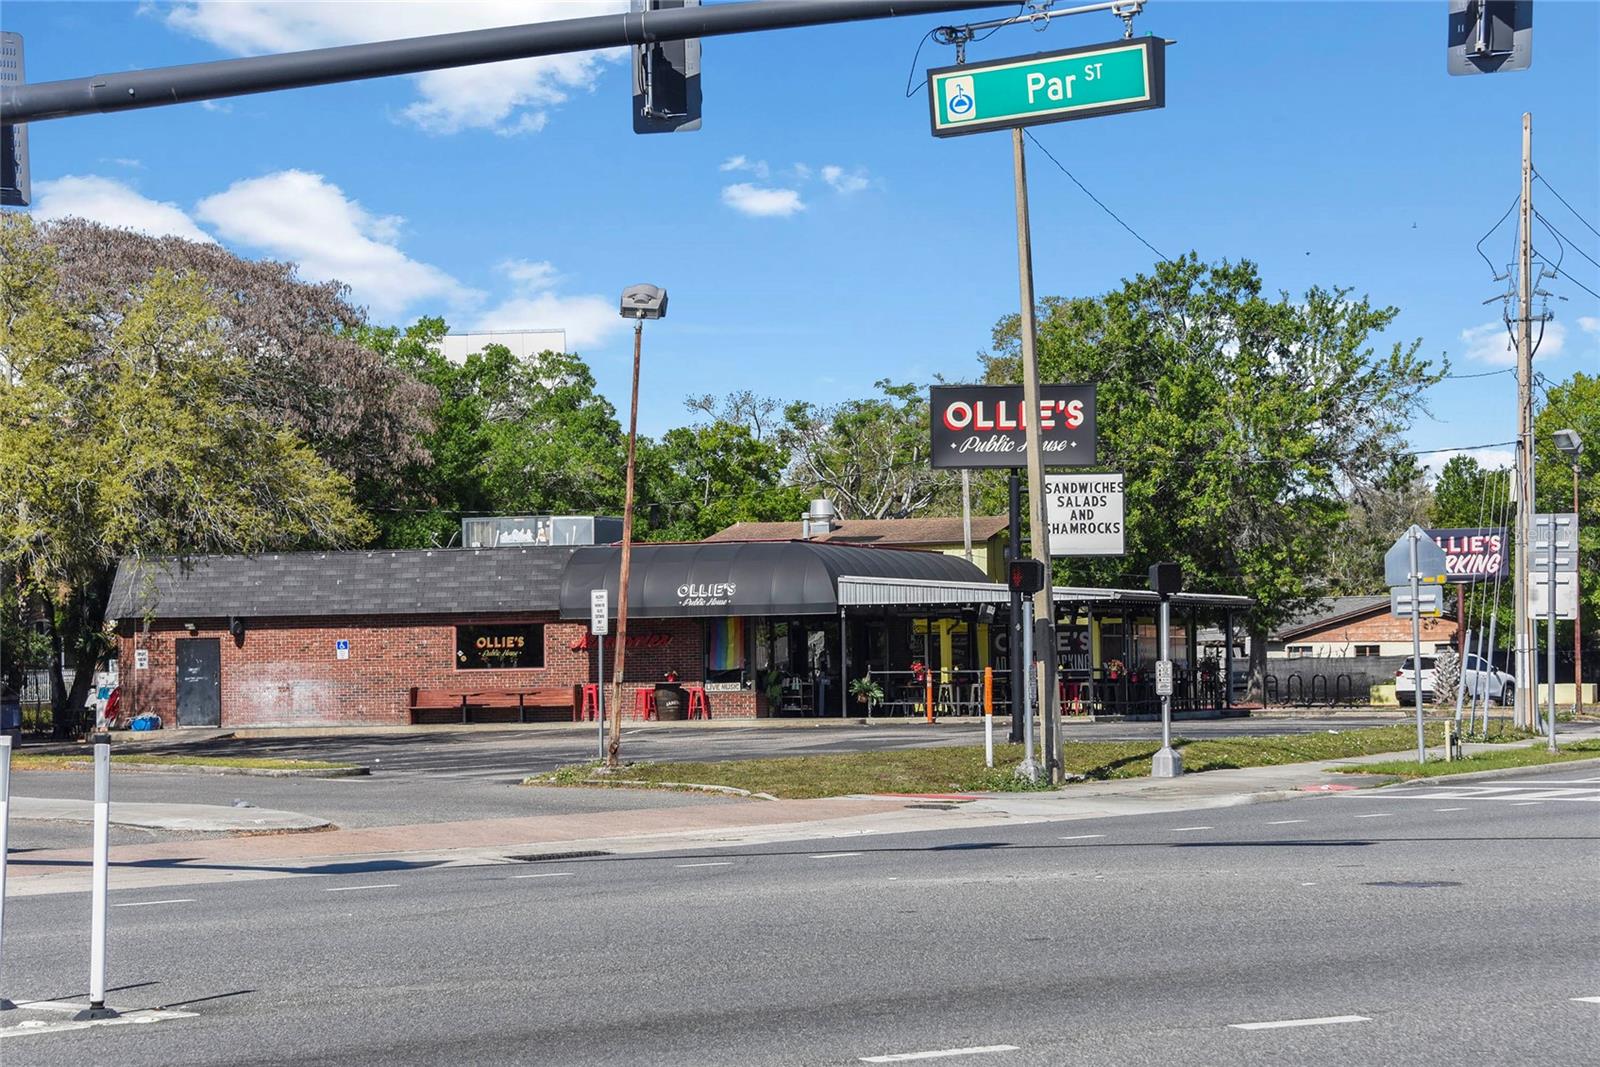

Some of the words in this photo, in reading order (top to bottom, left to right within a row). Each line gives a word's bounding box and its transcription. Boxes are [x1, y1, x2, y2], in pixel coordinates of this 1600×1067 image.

[1027, 72, 1076, 104] Par
[1084, 63, 1103, 81] ST
[943, 400, 1085, 431] OLLIE'S
[959, 434, 1015, 453] Public
[1017, 438, 1067, 453] use
[1045, 482, 1123, 494] SANDWICHES
[1057, 496, 1107, 507] SALADS
[1070, 509, 1094, 520] AND
[1433, 535, 1501, 554] LLIE'S
[1445, 553, 1501, 574] RKING
[677, 582, 737, 597] OLLIE'S
[475, 636, 525, 649] OLLIE'S
